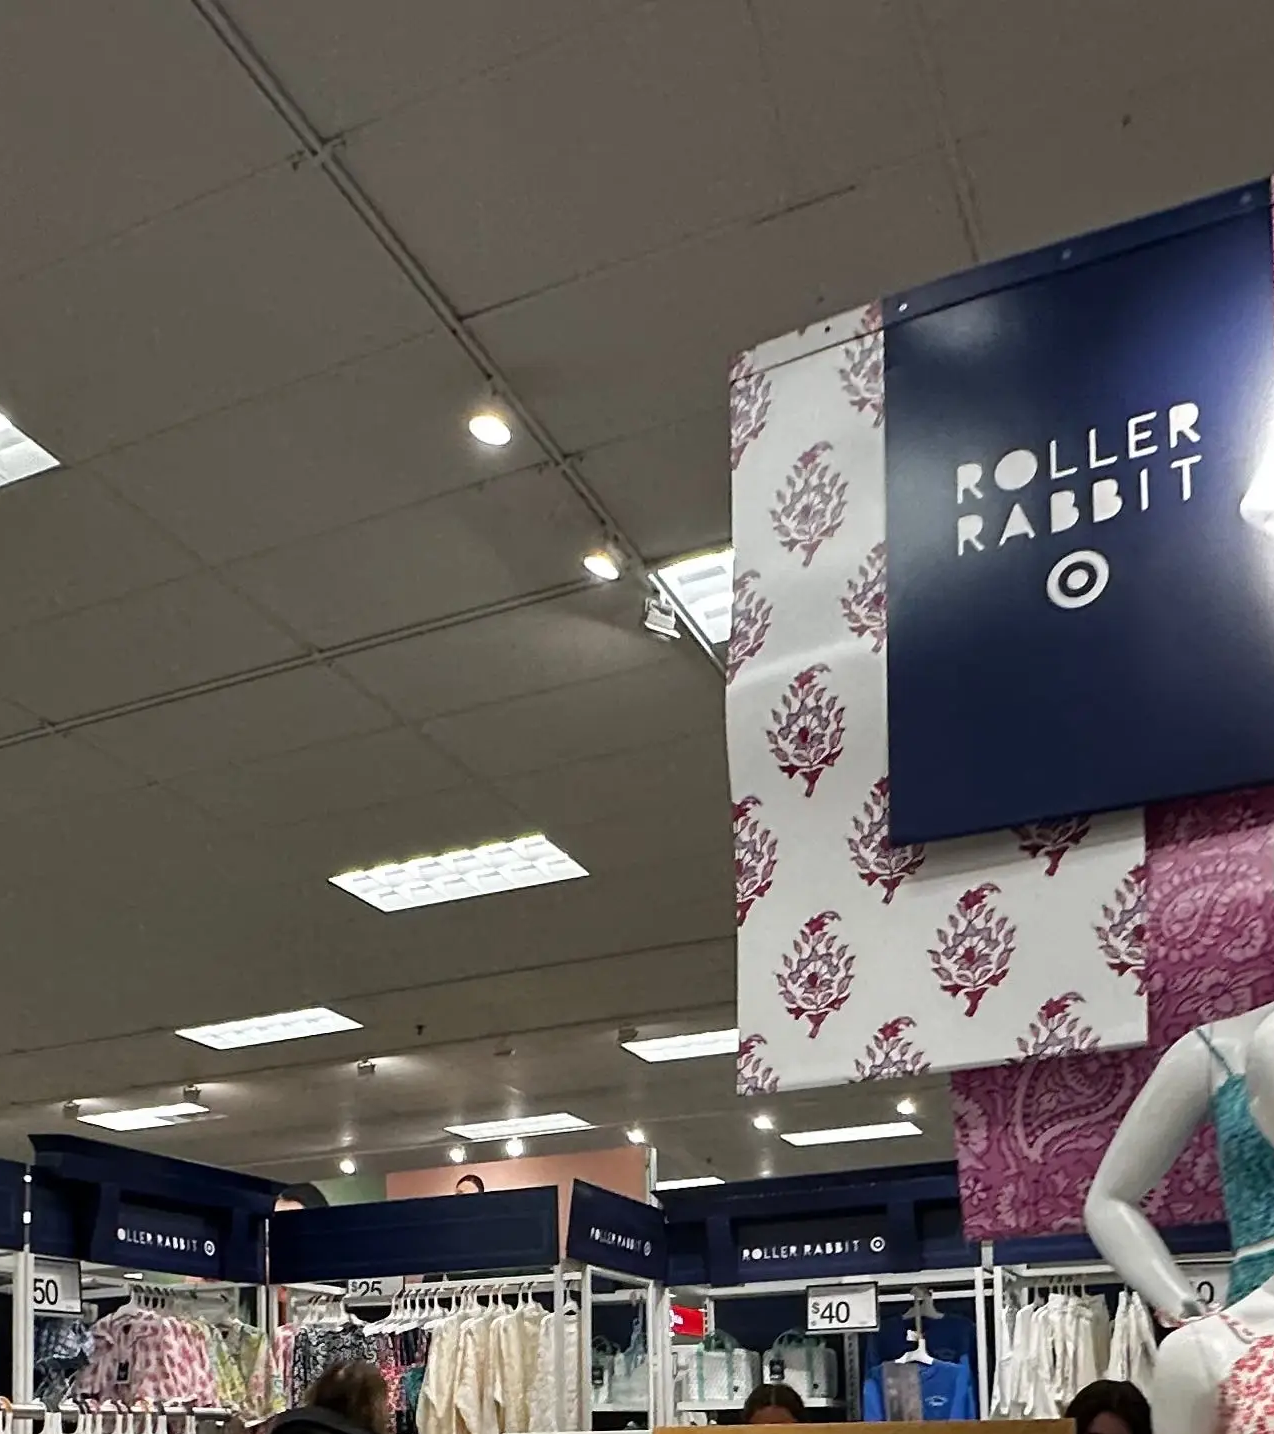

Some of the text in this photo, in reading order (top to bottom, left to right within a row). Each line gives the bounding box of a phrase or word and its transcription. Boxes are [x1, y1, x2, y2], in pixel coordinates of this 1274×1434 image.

[956, 400, 1203, 505] ROLLER
[956, 453, 1202, 557] RABBIT
[742, 1239, 860, 1262] ROLLER RABBIT
[811, 1300, 851, 1326] $40
